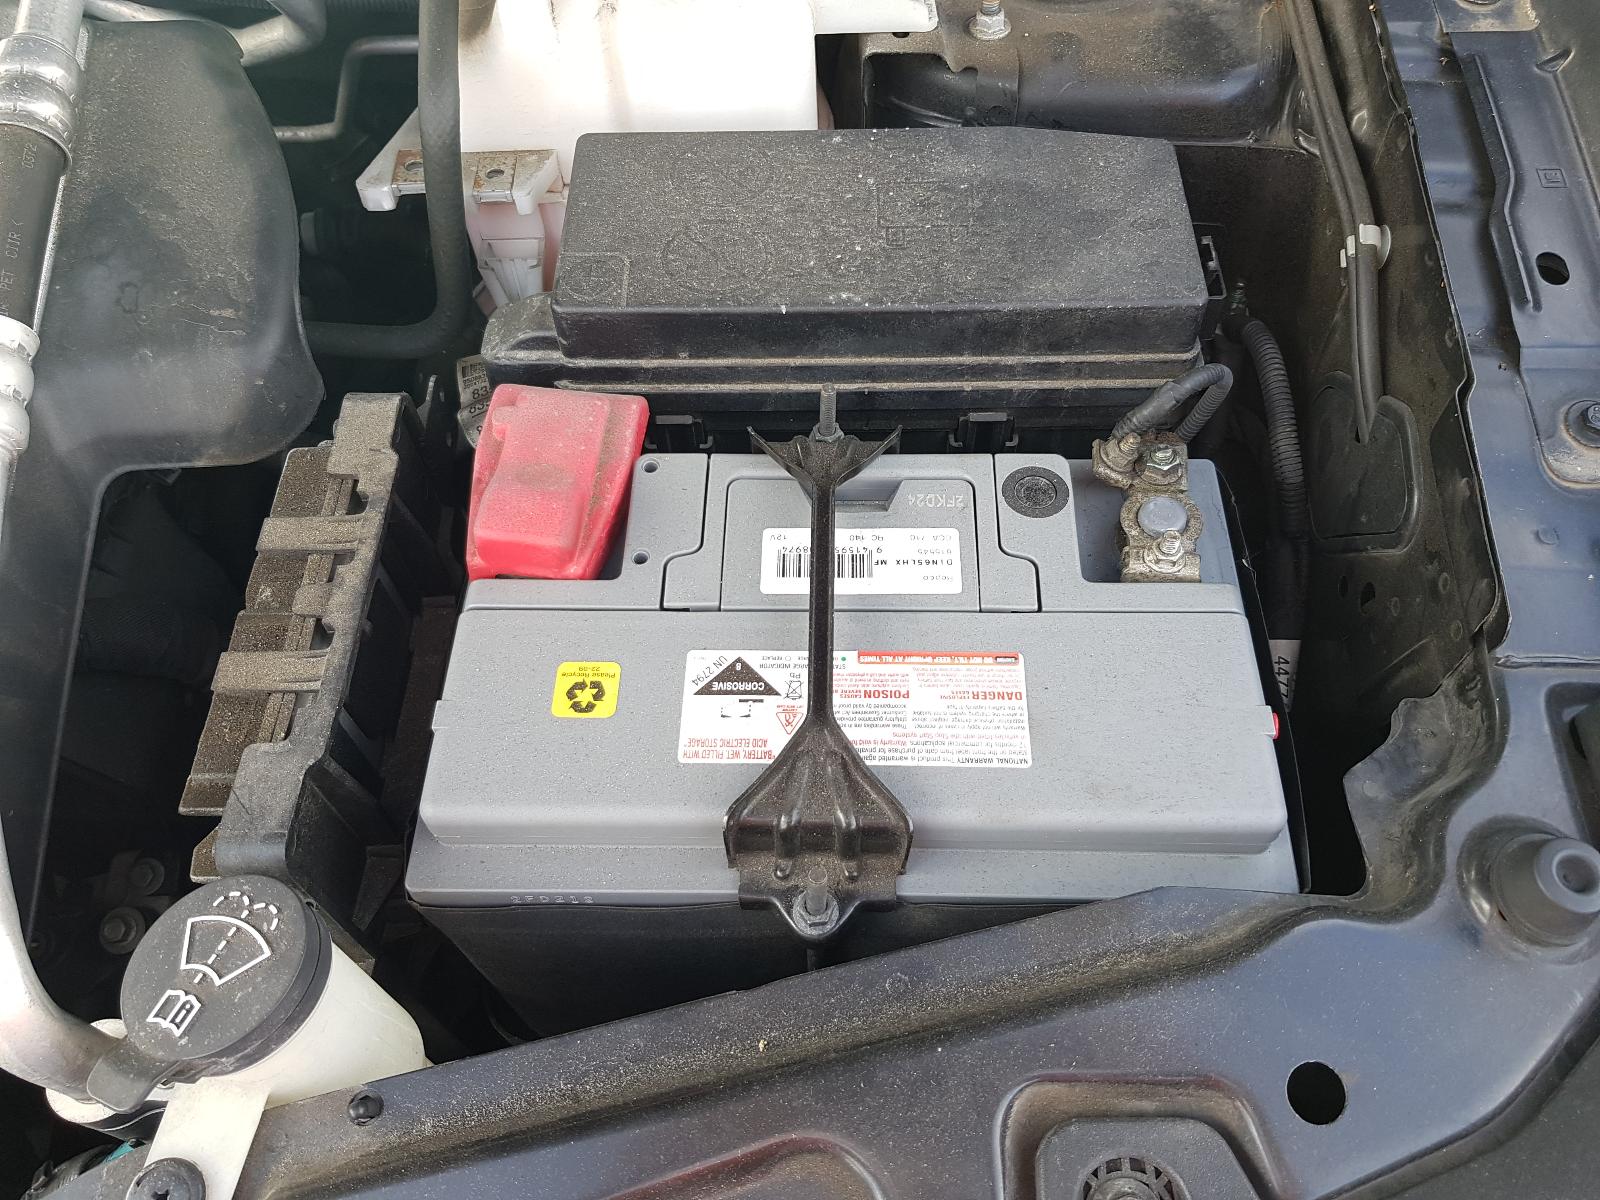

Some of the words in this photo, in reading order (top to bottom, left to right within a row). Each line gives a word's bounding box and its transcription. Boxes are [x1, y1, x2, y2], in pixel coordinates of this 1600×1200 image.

[713, 655, 727, 668] UN
[691, 667, 713, 686] 2794
[711, 681, 765, 691] CORROSIVE
[864, 690, 910, 699] POISON
[971, 690, 1023, 700] DANGER
[720, 738, 750, 748] ELECTRIC
[752, 738, 768, 748] ACID
[682, 749, 700, 759] WITH
[702, 750, 723, 759] FILLED
